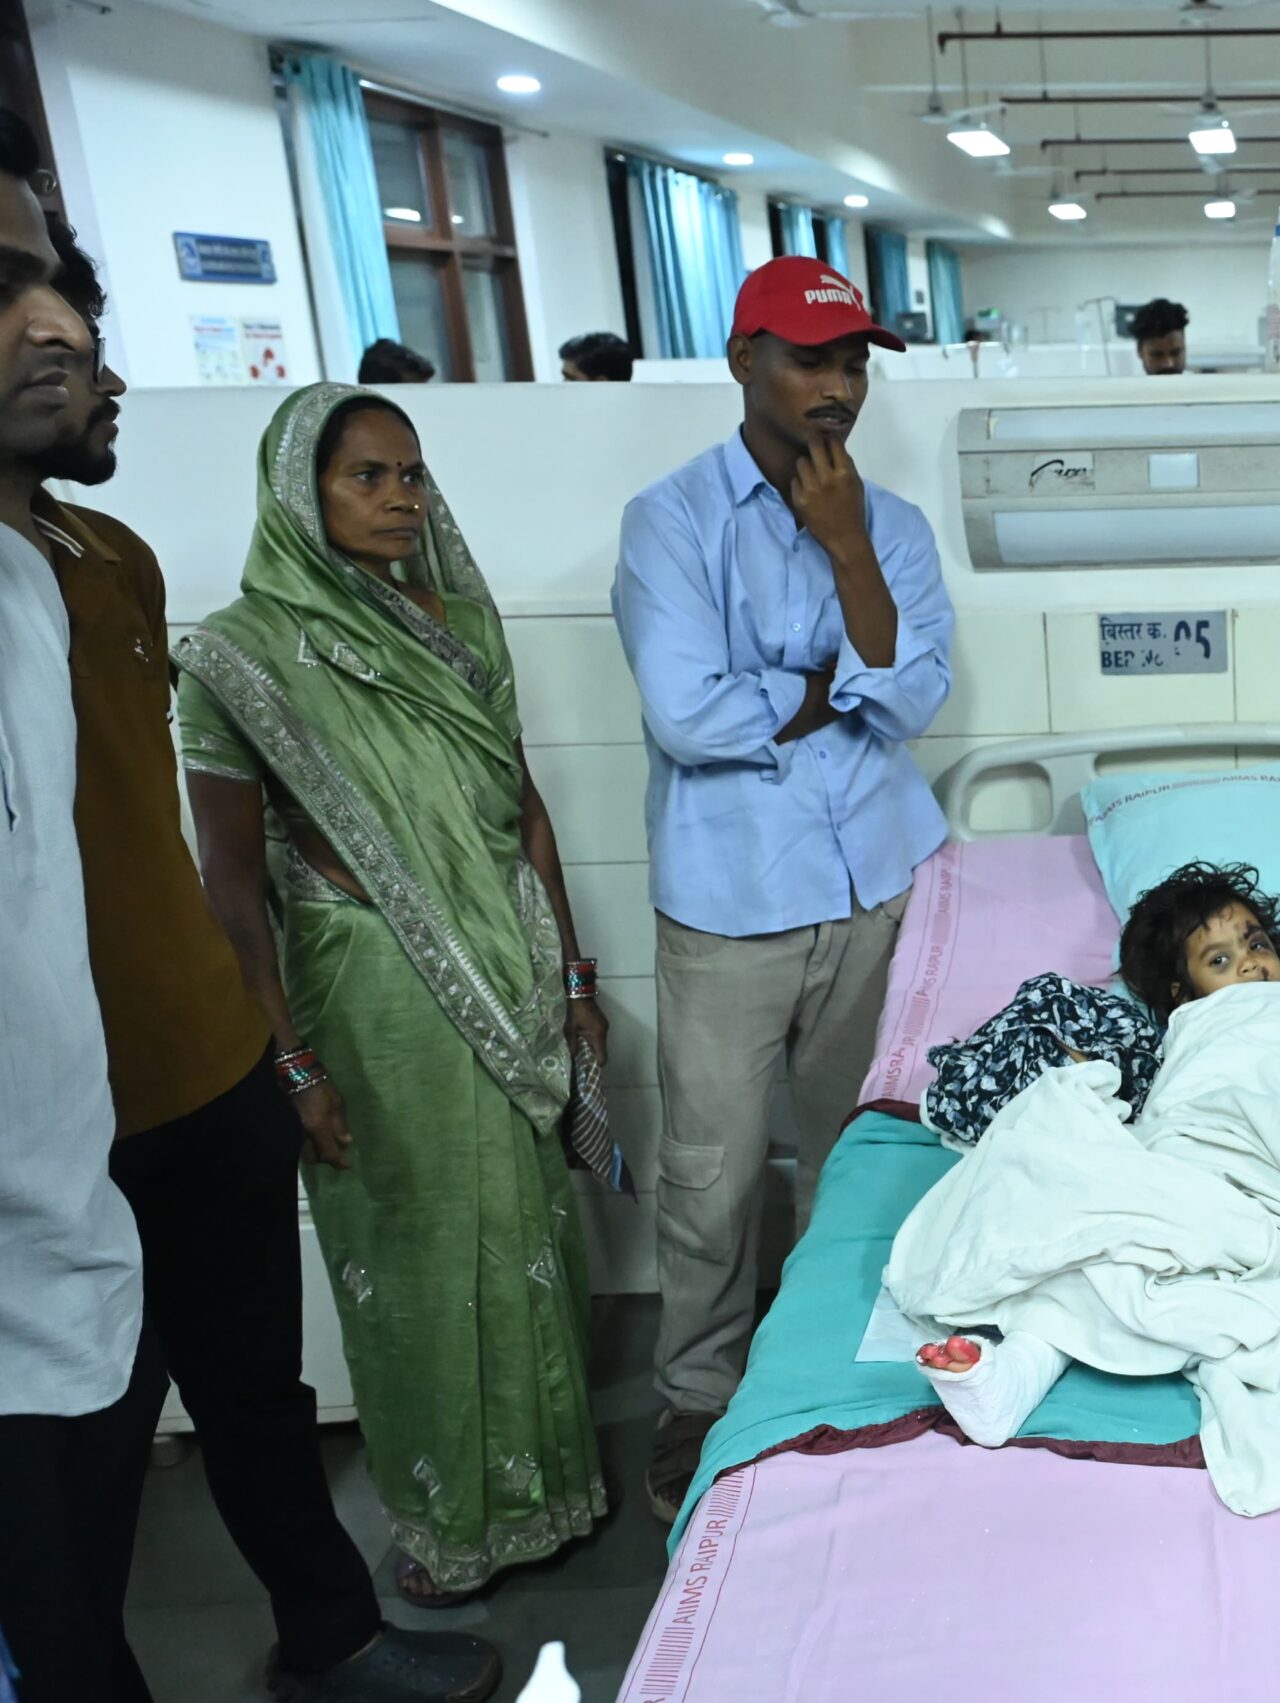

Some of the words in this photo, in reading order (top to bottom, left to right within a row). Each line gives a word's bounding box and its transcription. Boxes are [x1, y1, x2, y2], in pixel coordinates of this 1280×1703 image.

[804, 288, 852, 306] PUMA
[672, 1575, 708, 1625] AIIMS
[690, 1518, 728, 1573] RAIPUR
